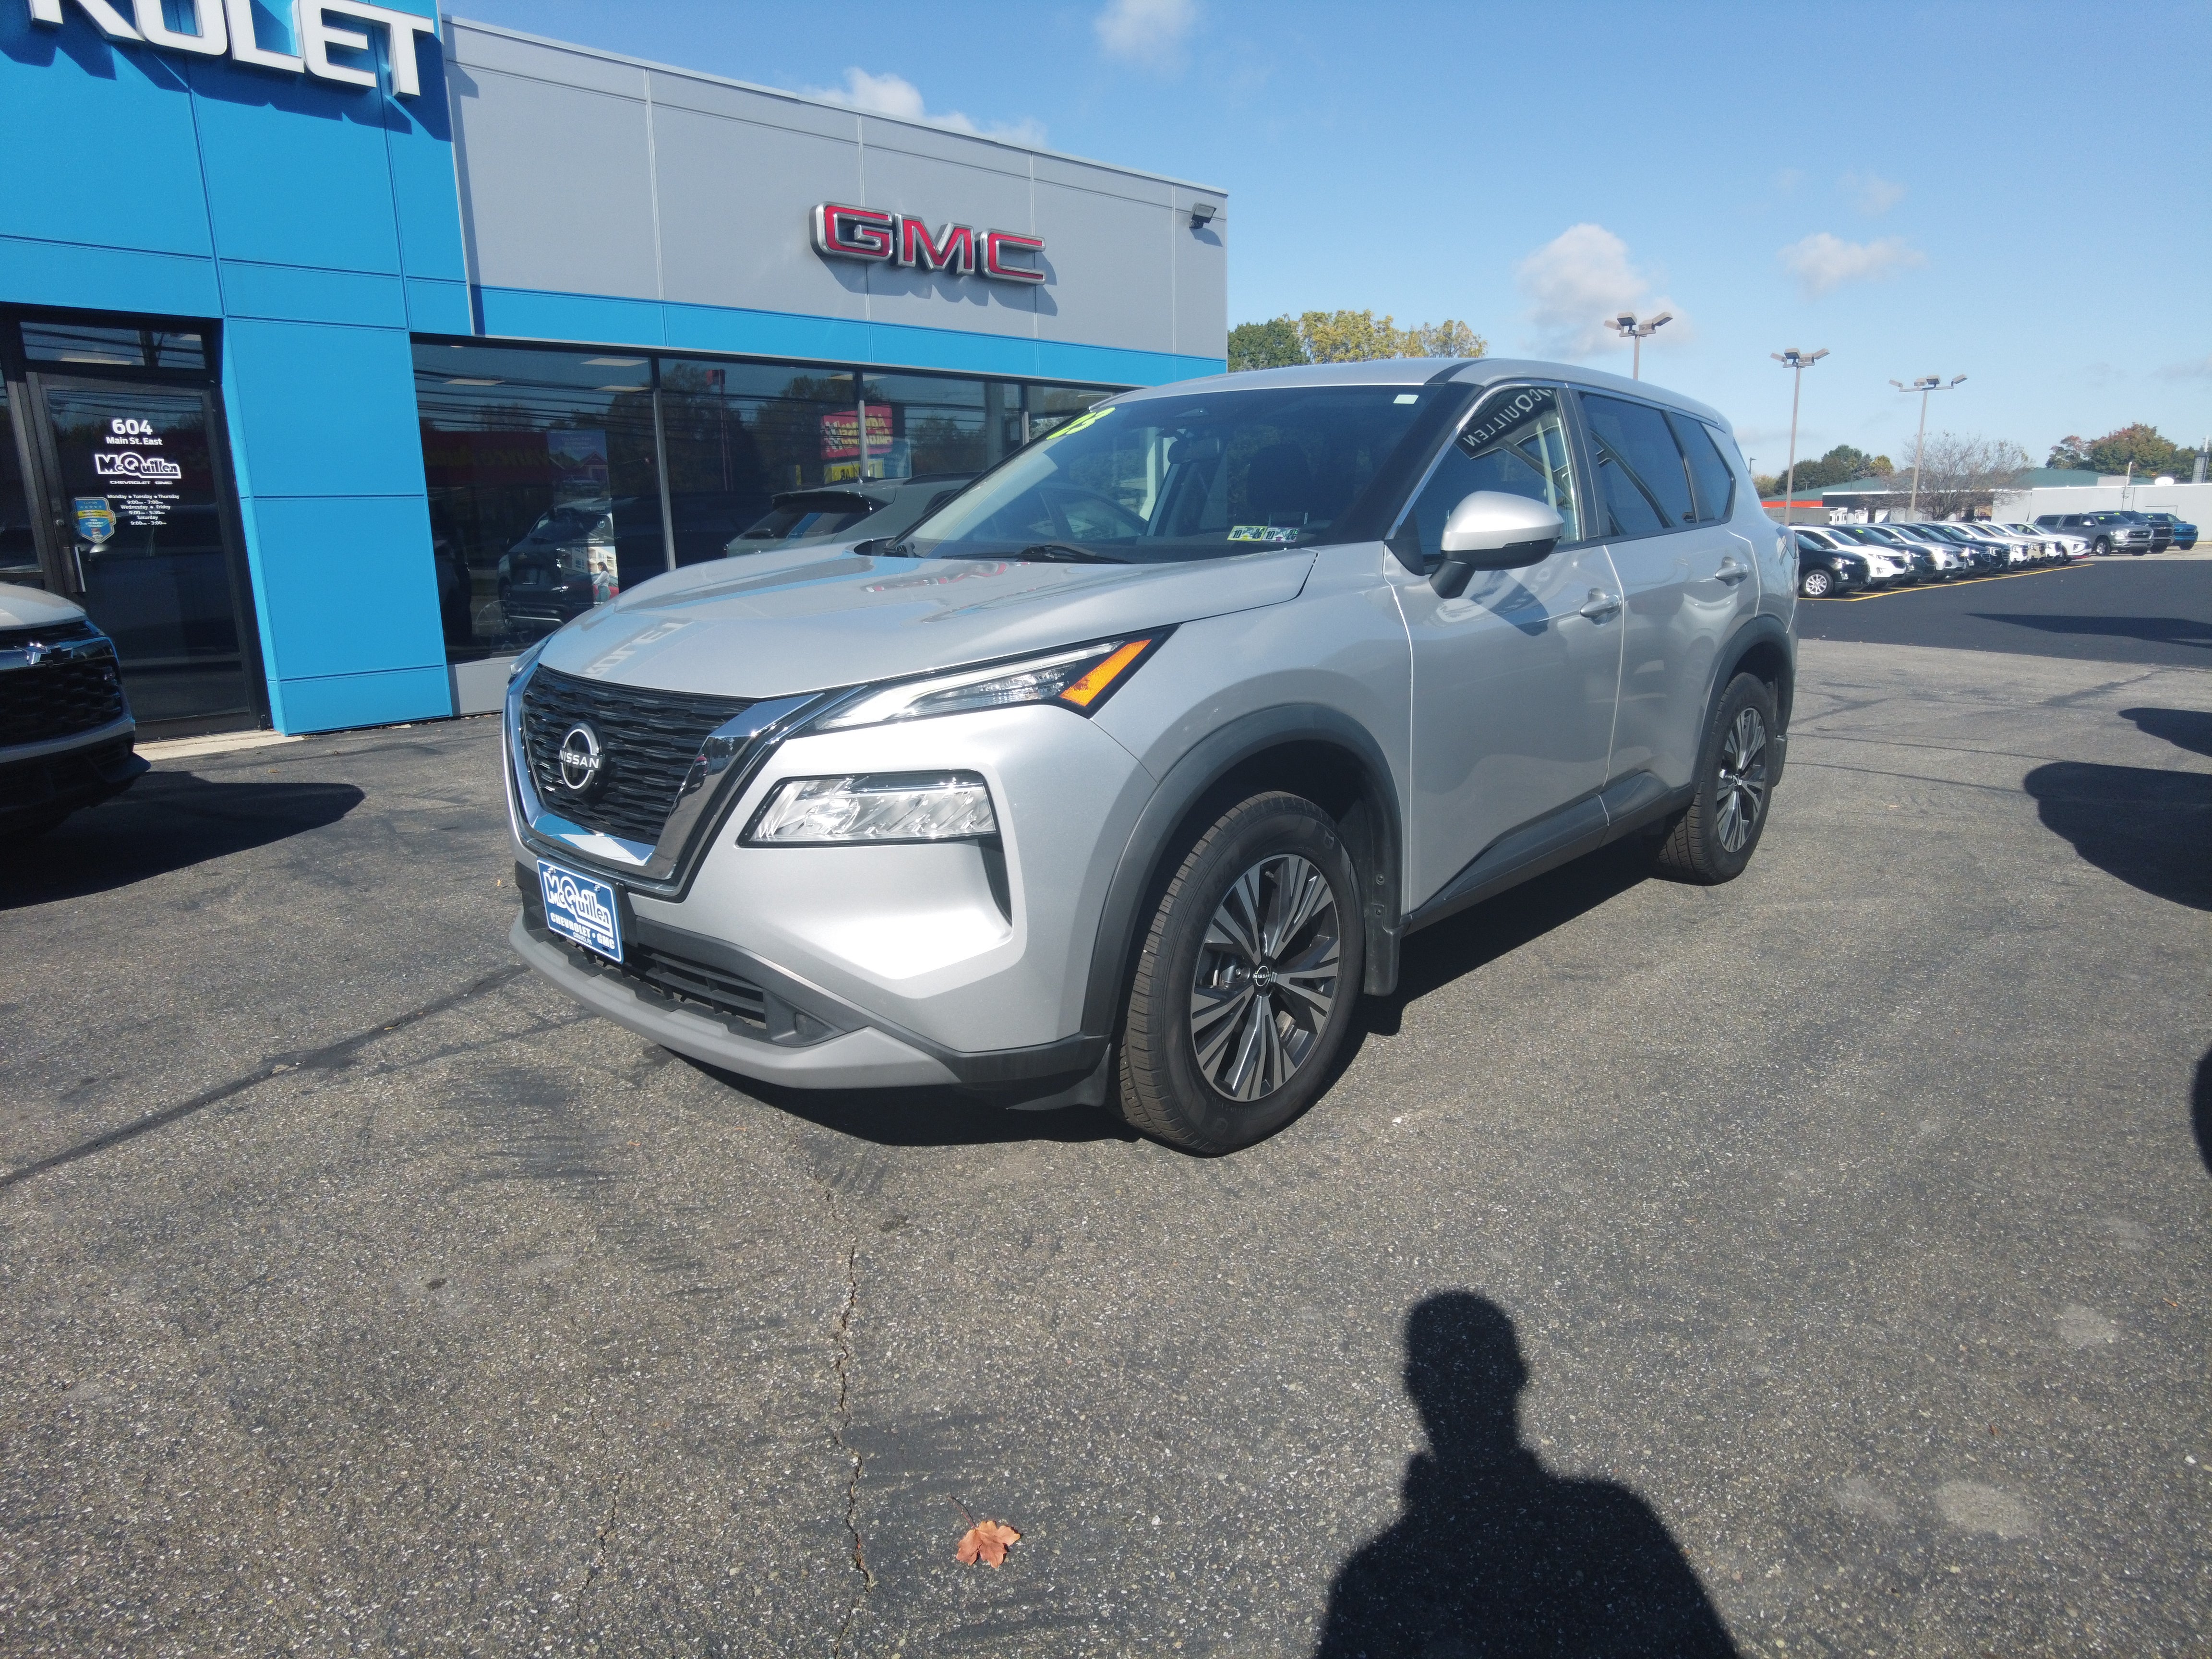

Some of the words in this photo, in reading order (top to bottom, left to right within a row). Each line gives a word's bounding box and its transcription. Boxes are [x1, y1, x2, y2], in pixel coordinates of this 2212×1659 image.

[809, 202, 1045, 285] GMC
[112, 419, 153, 435] 604
[95, 452, 181, 479] McQuillen
[1233, 530, 1242, 538] 10
[1266, 531, 1275, 539] 10
[559, 750, 599, 768] NISSAN
[543, 871, 613, 938] McQuillen
[550, 913, 591, 938] CHEVROLET
[597, 933, 615, 949] GMC
